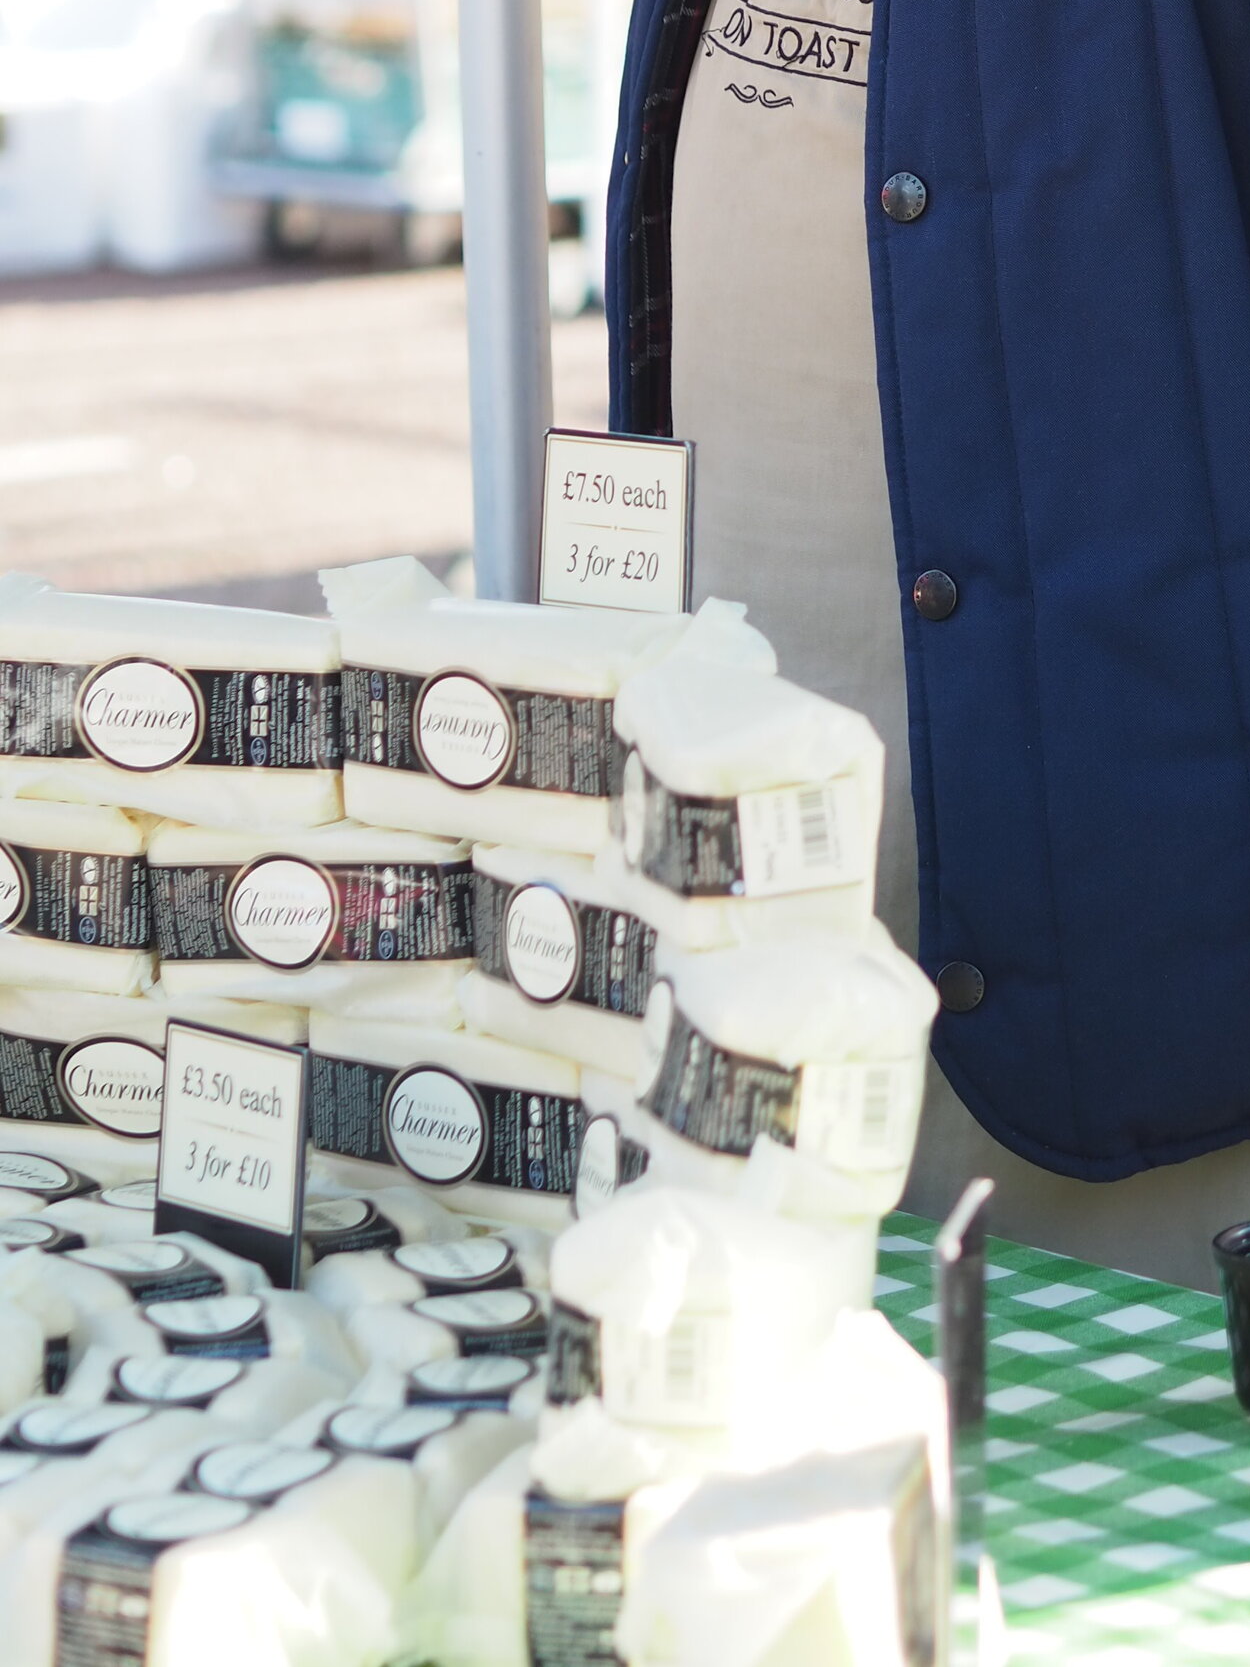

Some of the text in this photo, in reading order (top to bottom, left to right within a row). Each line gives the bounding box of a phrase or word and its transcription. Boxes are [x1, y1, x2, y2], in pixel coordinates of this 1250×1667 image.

[723, 7, 860, 73] ON TOAST
[562, 470, 667, 510] £7.50 each
[566, 543, 660, 583] 3 for £20
[86, 687, 194, 731] Charmer
[421, 712, 507, 761] Charmer
[234, 887, 329, 927] Charmer
[507, 909, 575, 963] Charmer
[68, 1064, 164, 1103] Charme
[182, 1064, 283, 1119] £3.50 each
[391, 1094, 480, 1145] Charmer
[185, 1140, 271, 1191] 3 for £10
